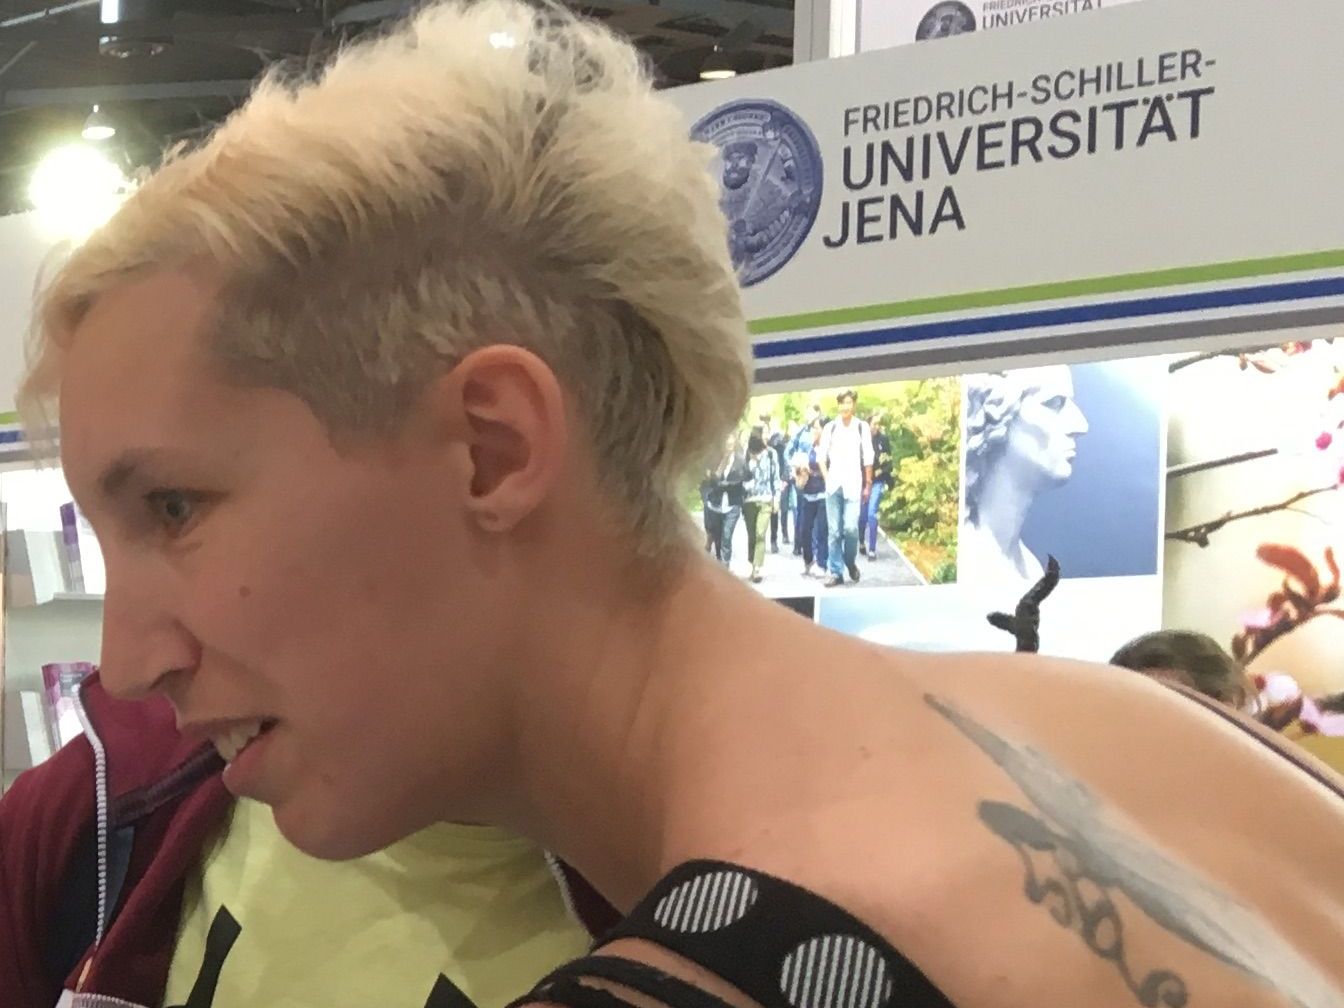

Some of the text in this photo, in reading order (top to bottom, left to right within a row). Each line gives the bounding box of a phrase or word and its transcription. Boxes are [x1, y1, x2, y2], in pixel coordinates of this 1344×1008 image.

[844, 49, 1217, 136] FRIEDRICH-SCHILLER-
[844, 87, 1215, 190] UNIVERSITÄT
[823, 186, 966, 249] JENA
